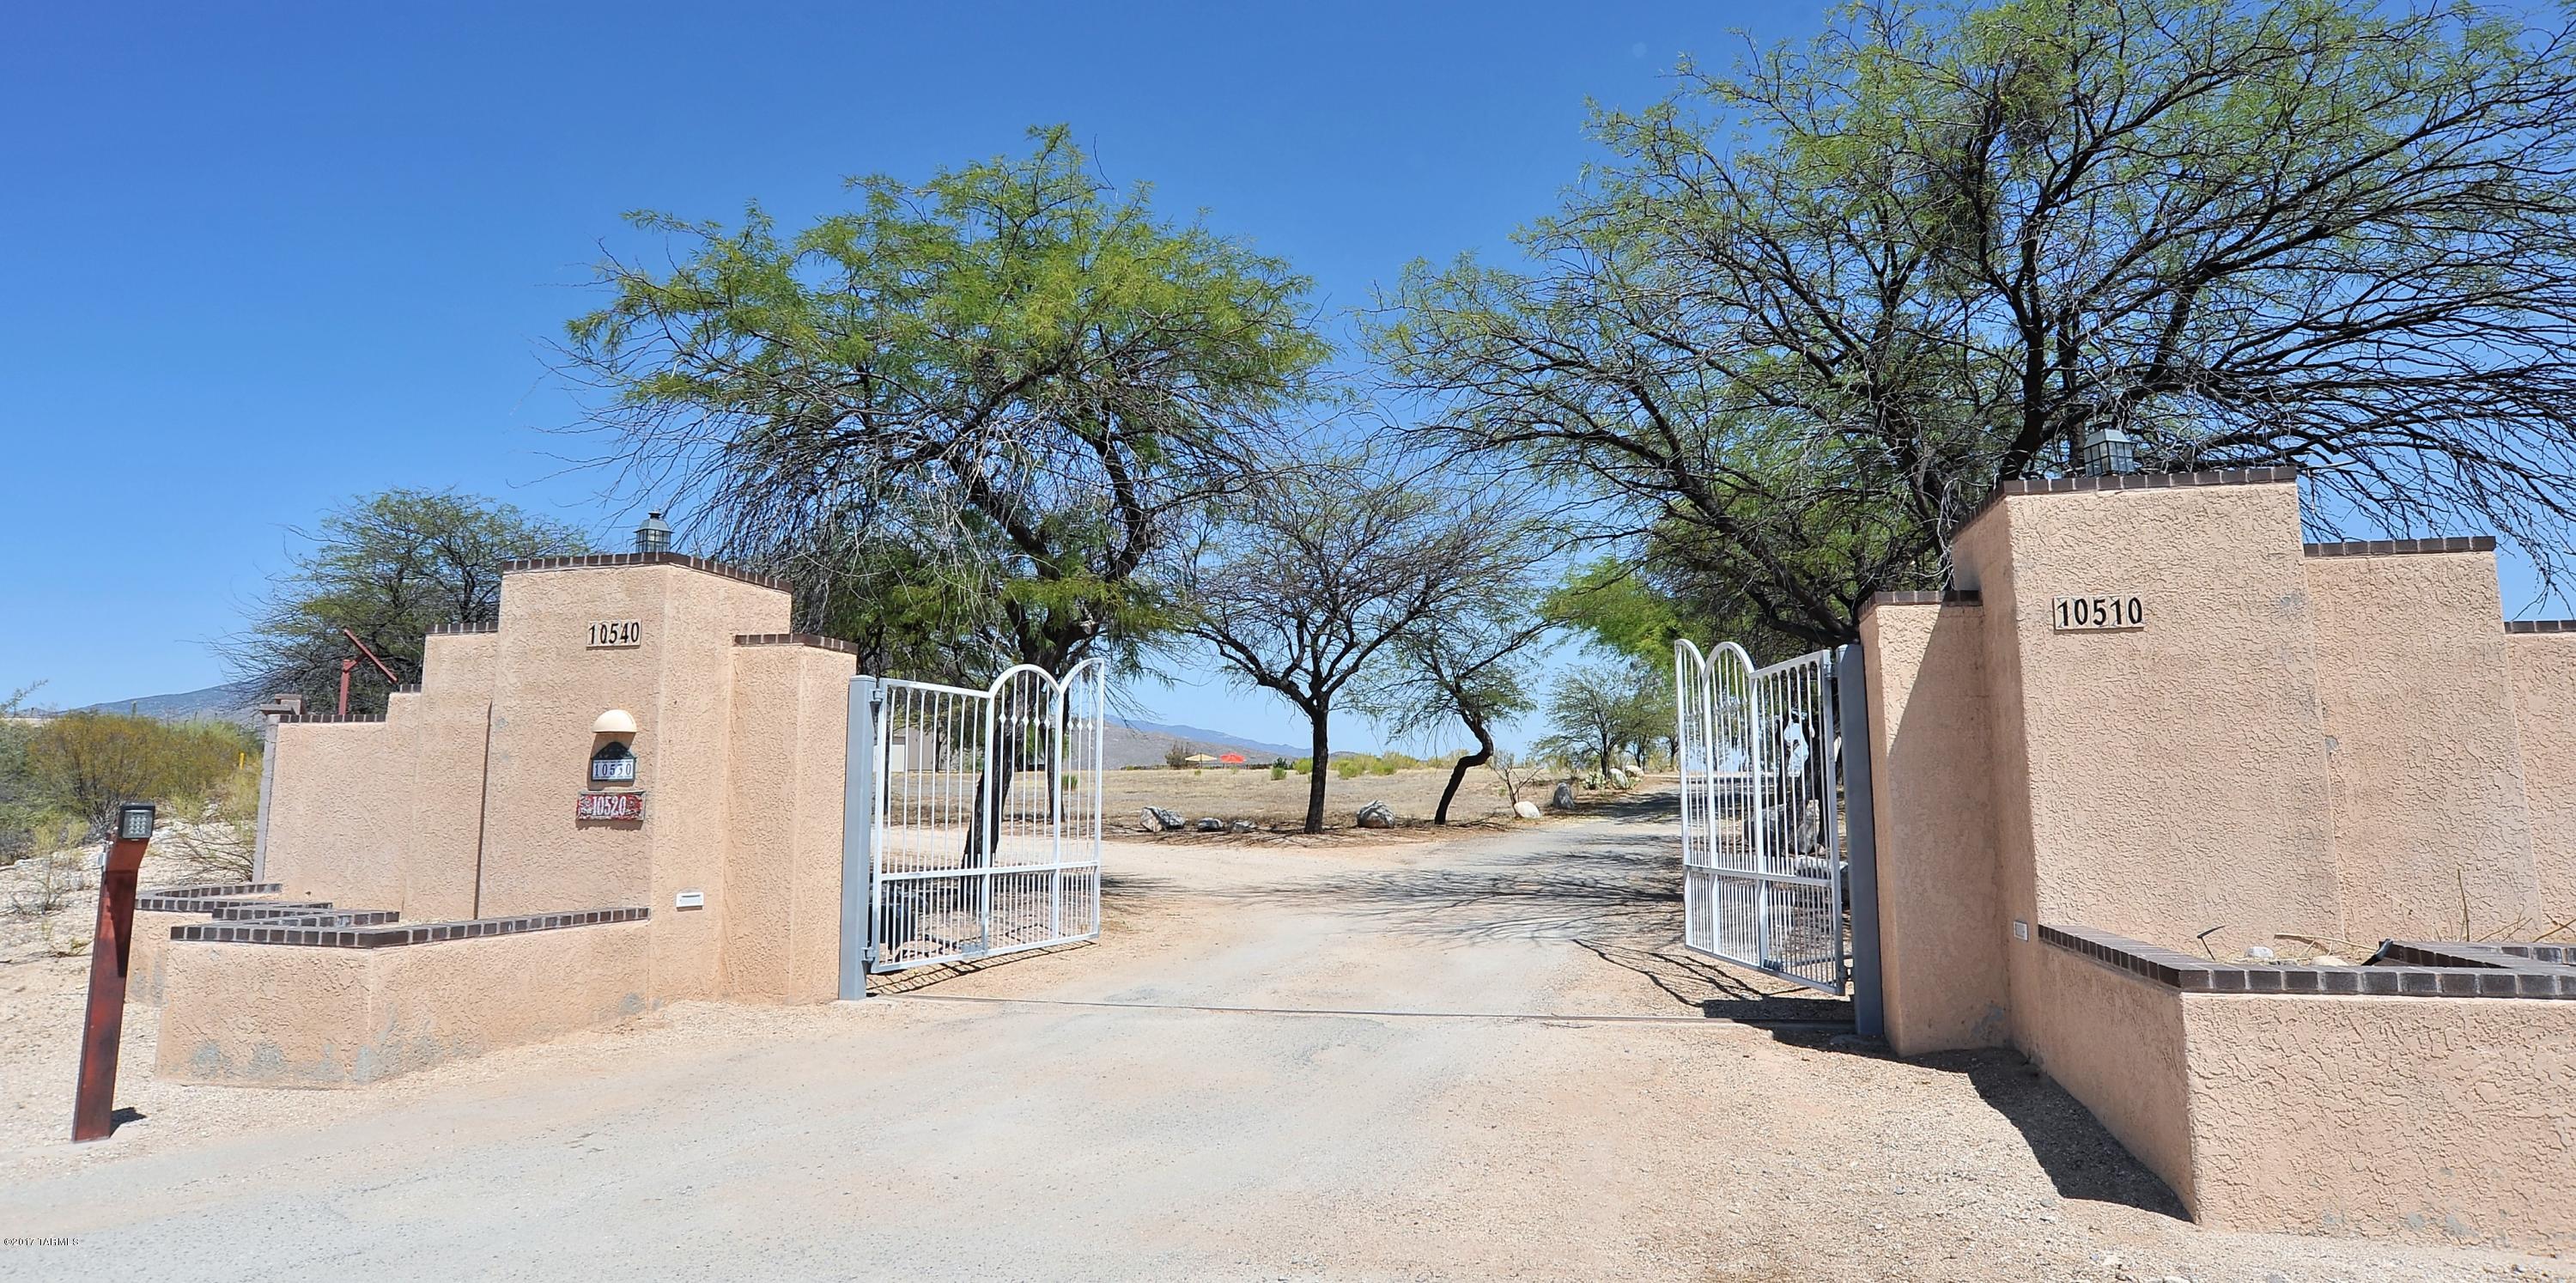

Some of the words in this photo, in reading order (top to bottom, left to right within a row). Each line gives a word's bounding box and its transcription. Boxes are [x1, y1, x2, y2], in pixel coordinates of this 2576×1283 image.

[2057, 597, 2142, 626] 10510
[588, 622, 640, 645] 10540
[592, 795, 627, 816] 10520
